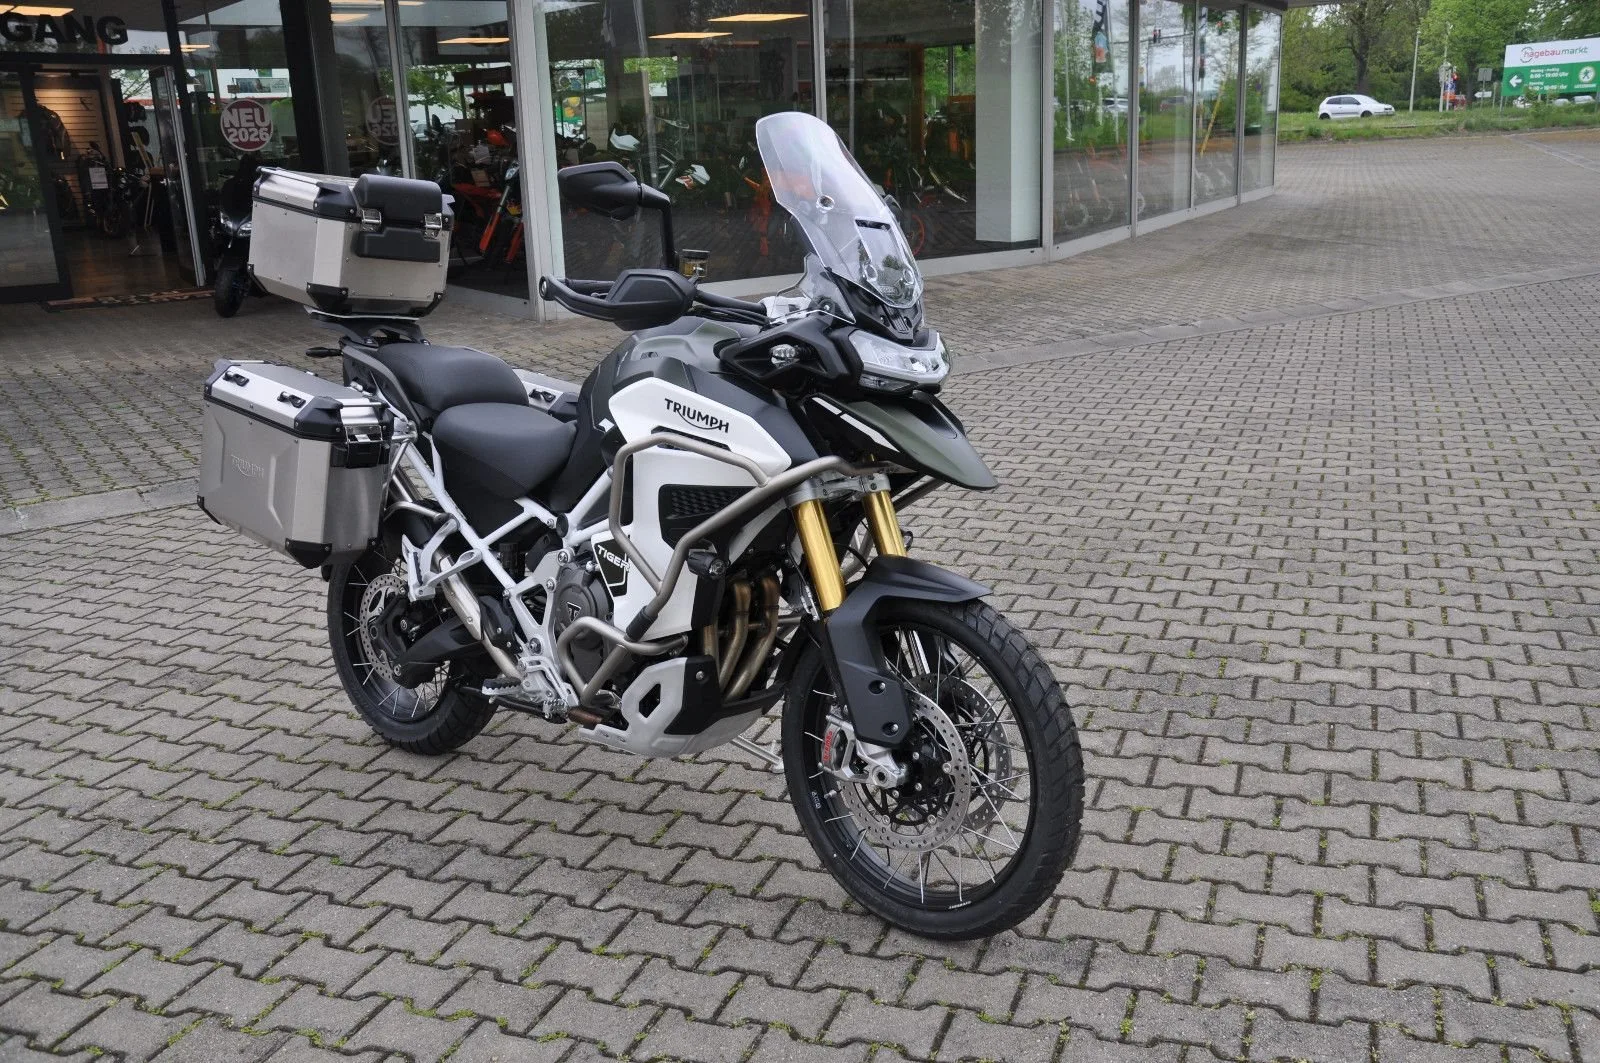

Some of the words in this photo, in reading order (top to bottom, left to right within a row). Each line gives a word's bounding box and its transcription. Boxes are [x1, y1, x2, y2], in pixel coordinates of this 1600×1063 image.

[1523, 46, 1588, 59] hagebaumarkt
[223, 107, 271, 128] NEU
[227, 127, 270, 143] 2026
[664, 398, 729, 433] TRIUMPH
[597, 544, 630, 572] TIGER
